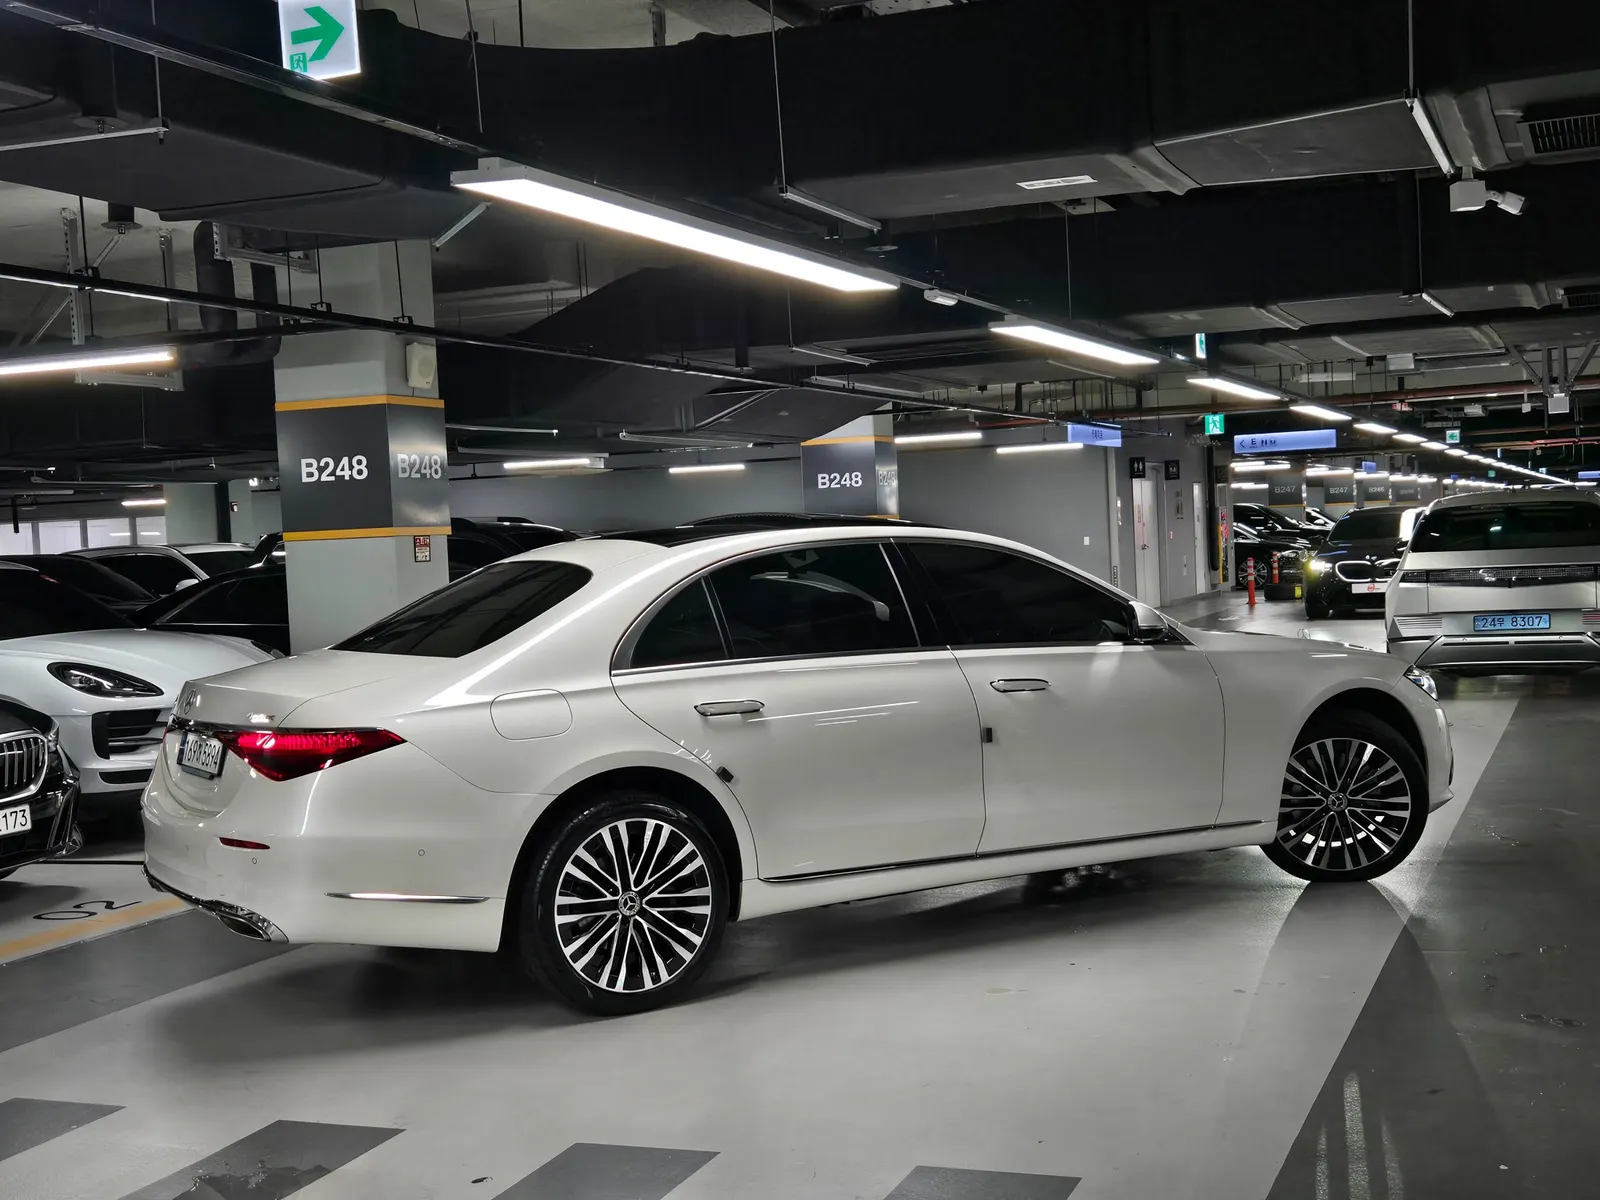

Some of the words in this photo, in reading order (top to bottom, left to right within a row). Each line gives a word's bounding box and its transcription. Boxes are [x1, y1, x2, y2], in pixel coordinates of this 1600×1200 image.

[300, 454, 369, 483] B248
[397, 453, 442, 479] B248
[817, 471, 863, 489] B248
[878, 471, 895, 486] B248
[1274, 485, 1296, 493] B247
[1329, 486, 1348, 494] B247
[1481, 617, 1505, 628] 24우
[1510, 615, 1543, 627] 8307
[0, 808, 28, 831] 173
[32, 900, 143, 921] 02
